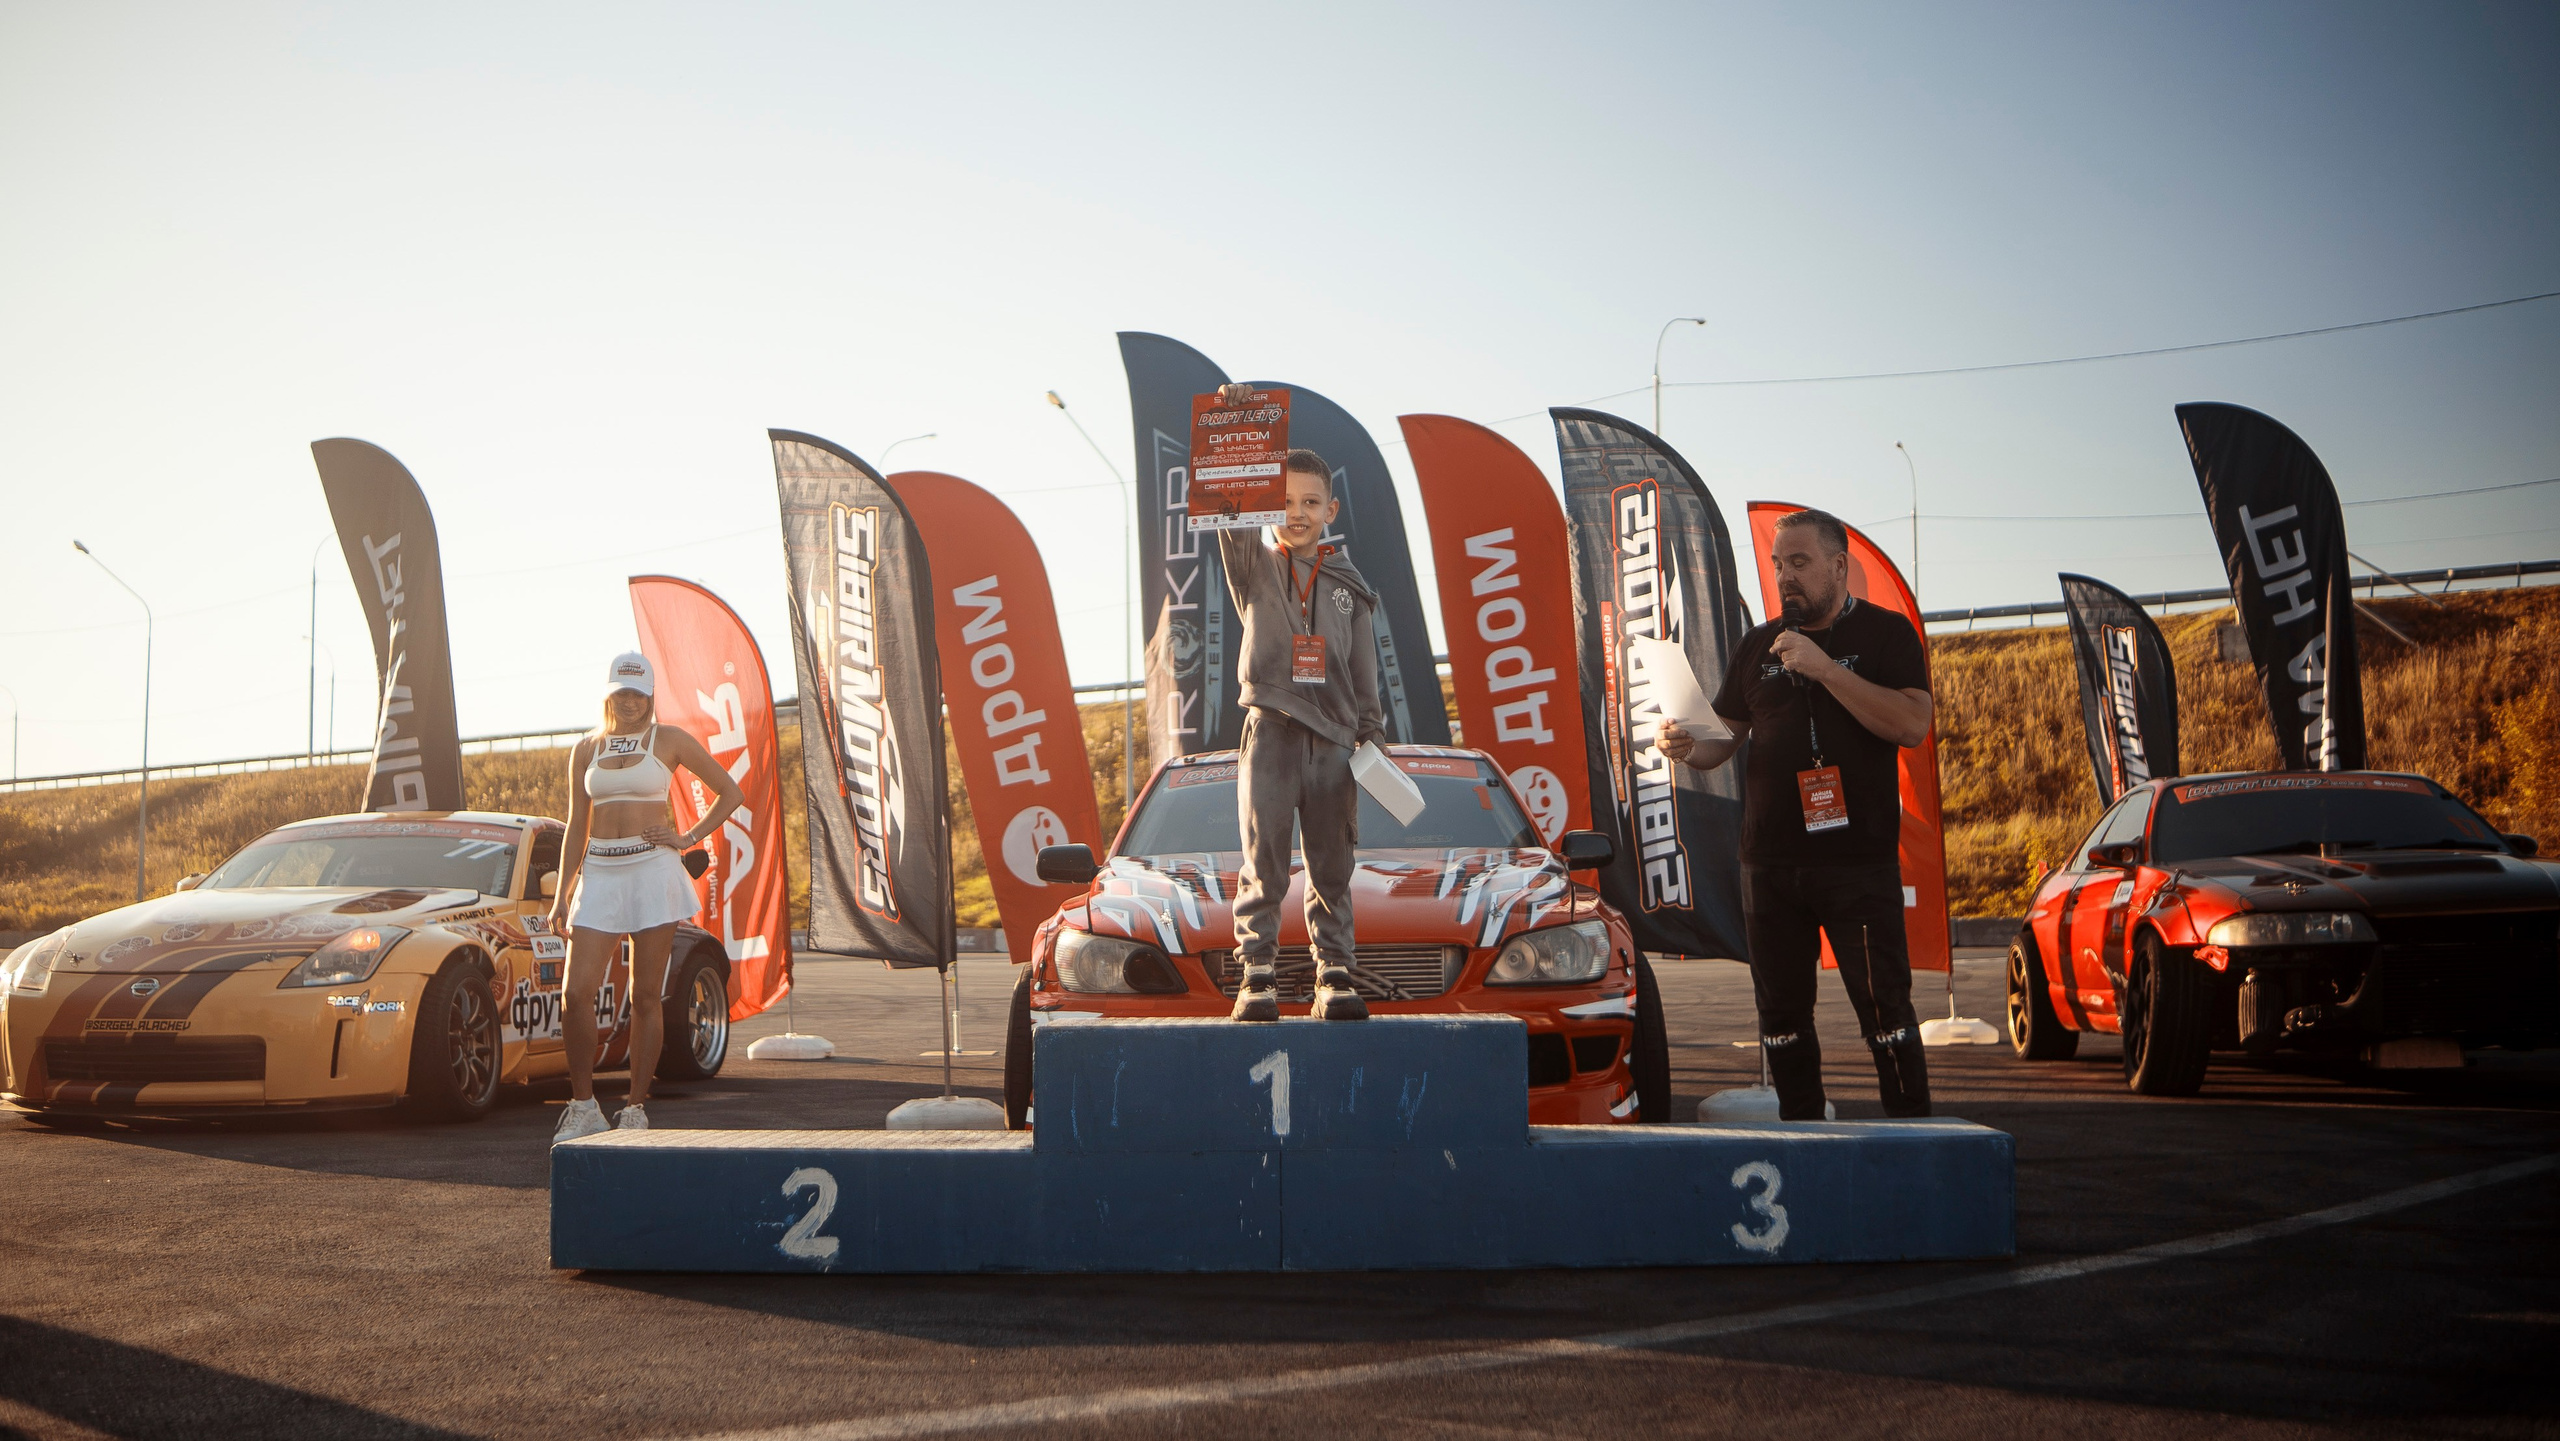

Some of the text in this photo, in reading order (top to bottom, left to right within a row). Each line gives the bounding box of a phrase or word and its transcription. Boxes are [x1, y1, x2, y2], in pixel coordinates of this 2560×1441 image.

[1213, 393, 1268, 403] SKER
[1198, 408, 1283, 425] DRIFT LETO
[1209, 431, 1269, 443] ДИПЛОМ
[1227, 443, 1264, 451] УЧАСТИЕ
[2239, 504, 2318, 626] НЕТ
[1165, 466, 1200, 757] ROKER
[1208, 610, 1221, 684] TEAM
[1380, 635, 1405, 707] TEAM
[609, 737, 639, 753] SM
[1180, 764, 1238, 784] DRI
[443, 838, 509, 859] 77
[327, 995, 407, 1013] RACE WORK
[1250, 1050, 1290, 1136] 1
[779, 1167, 840, 1260] 2
[1731, 1160, 1790, 1254] 3
